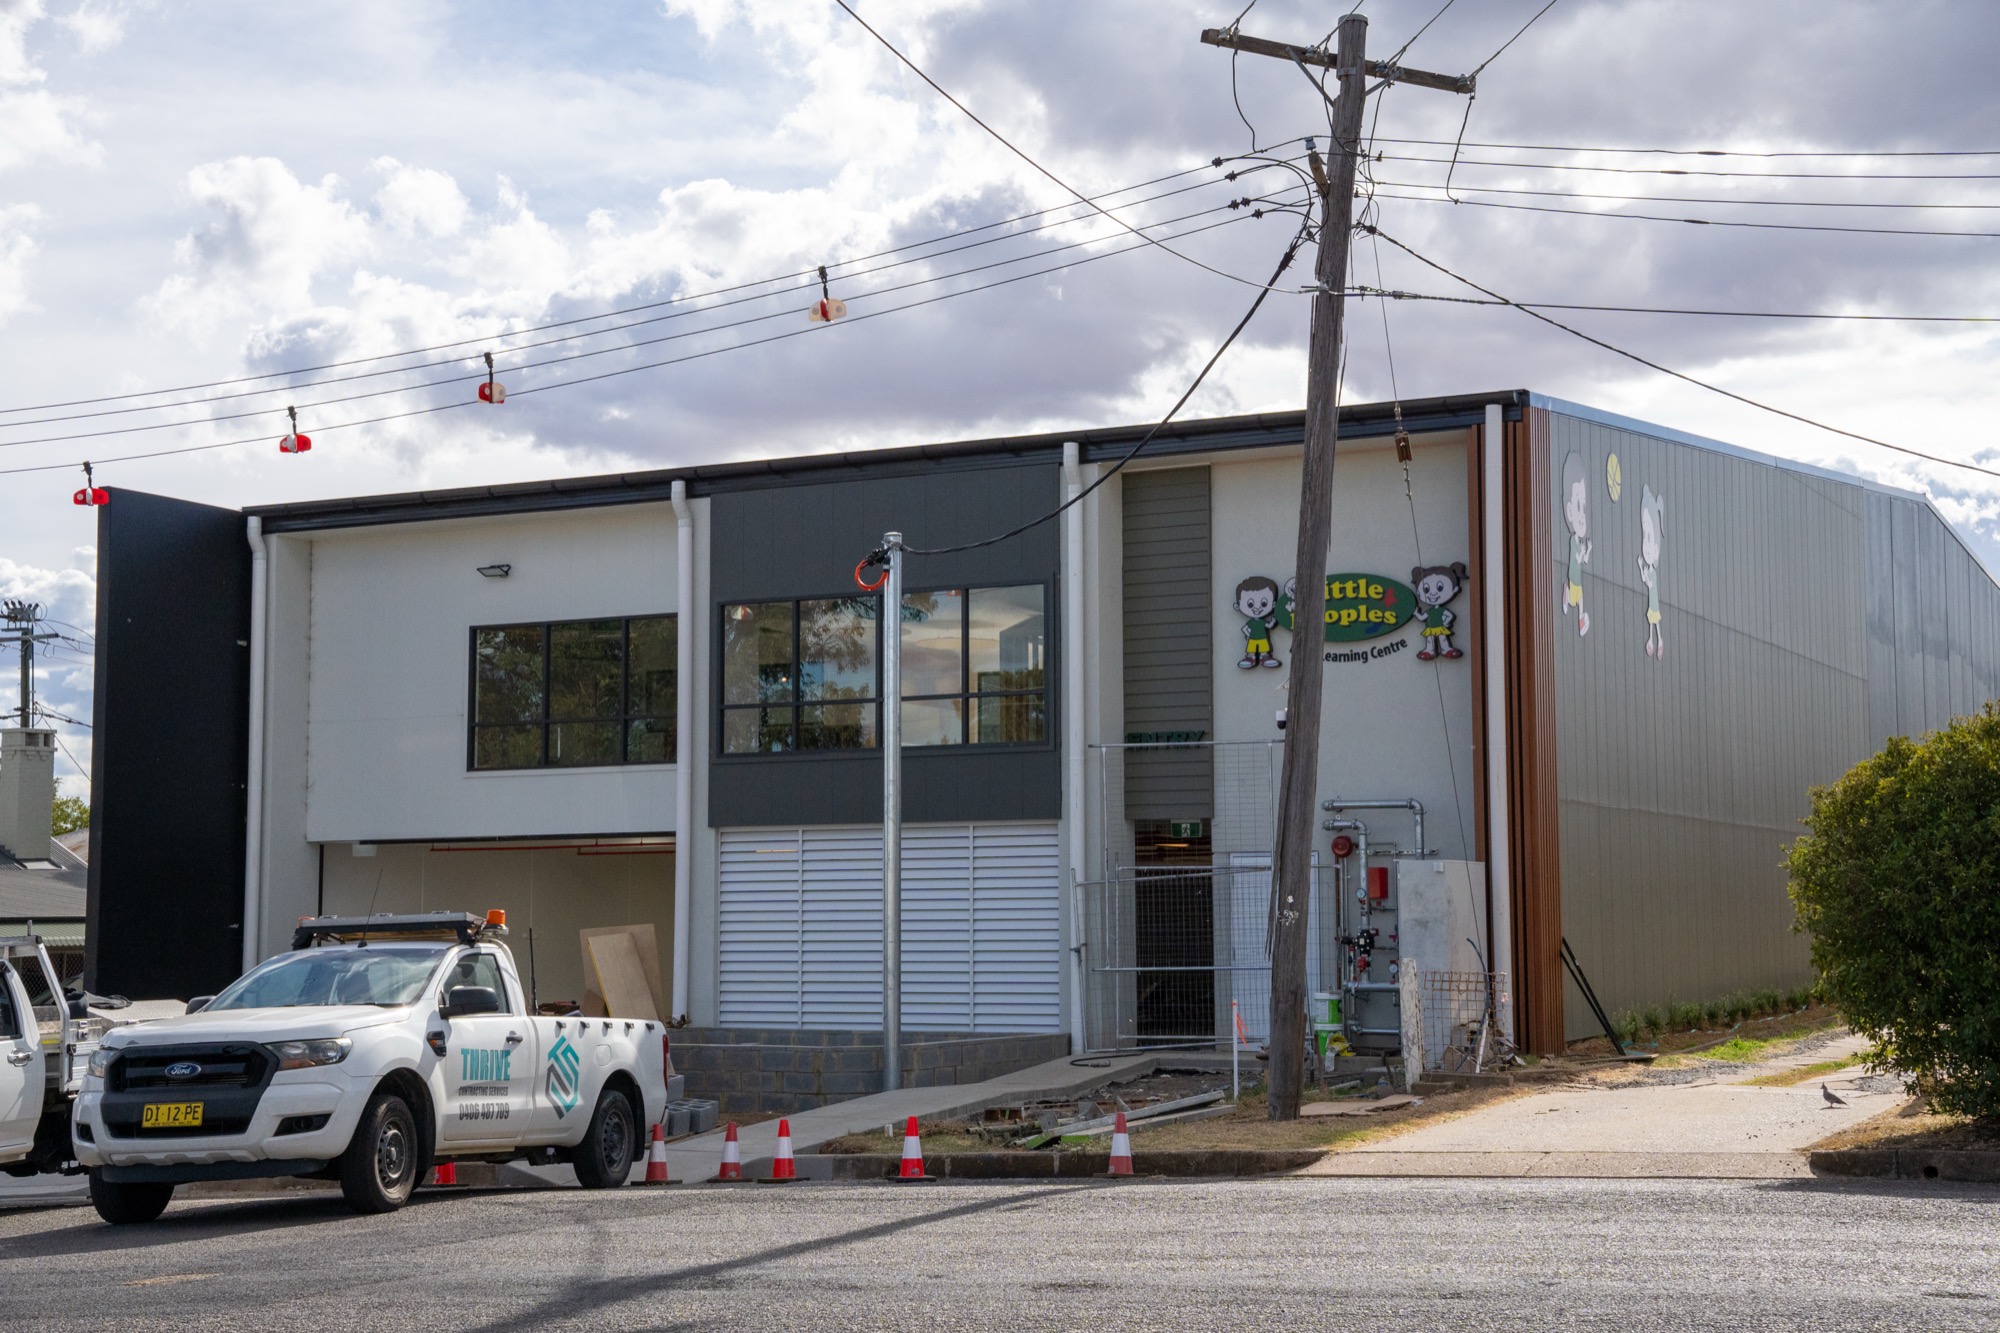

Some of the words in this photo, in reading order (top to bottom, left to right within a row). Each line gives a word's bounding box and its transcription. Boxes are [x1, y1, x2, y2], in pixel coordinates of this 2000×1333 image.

[1325, 579, 1384, 599] ittle
[1290, 605, 1397, 630] oples
[1323, 650, 1369, 664] earning
[1370, 638, 1408, 659] Centre
[1126, 730, 1206, 751] ENTRY
[171, 1064, 192, 1075] Ford
[461, 1048, 511, 1081] THRIVE
[458, 1086, 488, 1096] CONTRACTING
[489, 1086, 509, 1096] SERVICES
[459, 1103, 480, 1120] 0406
[481, 1103, 495, 1120] 487
